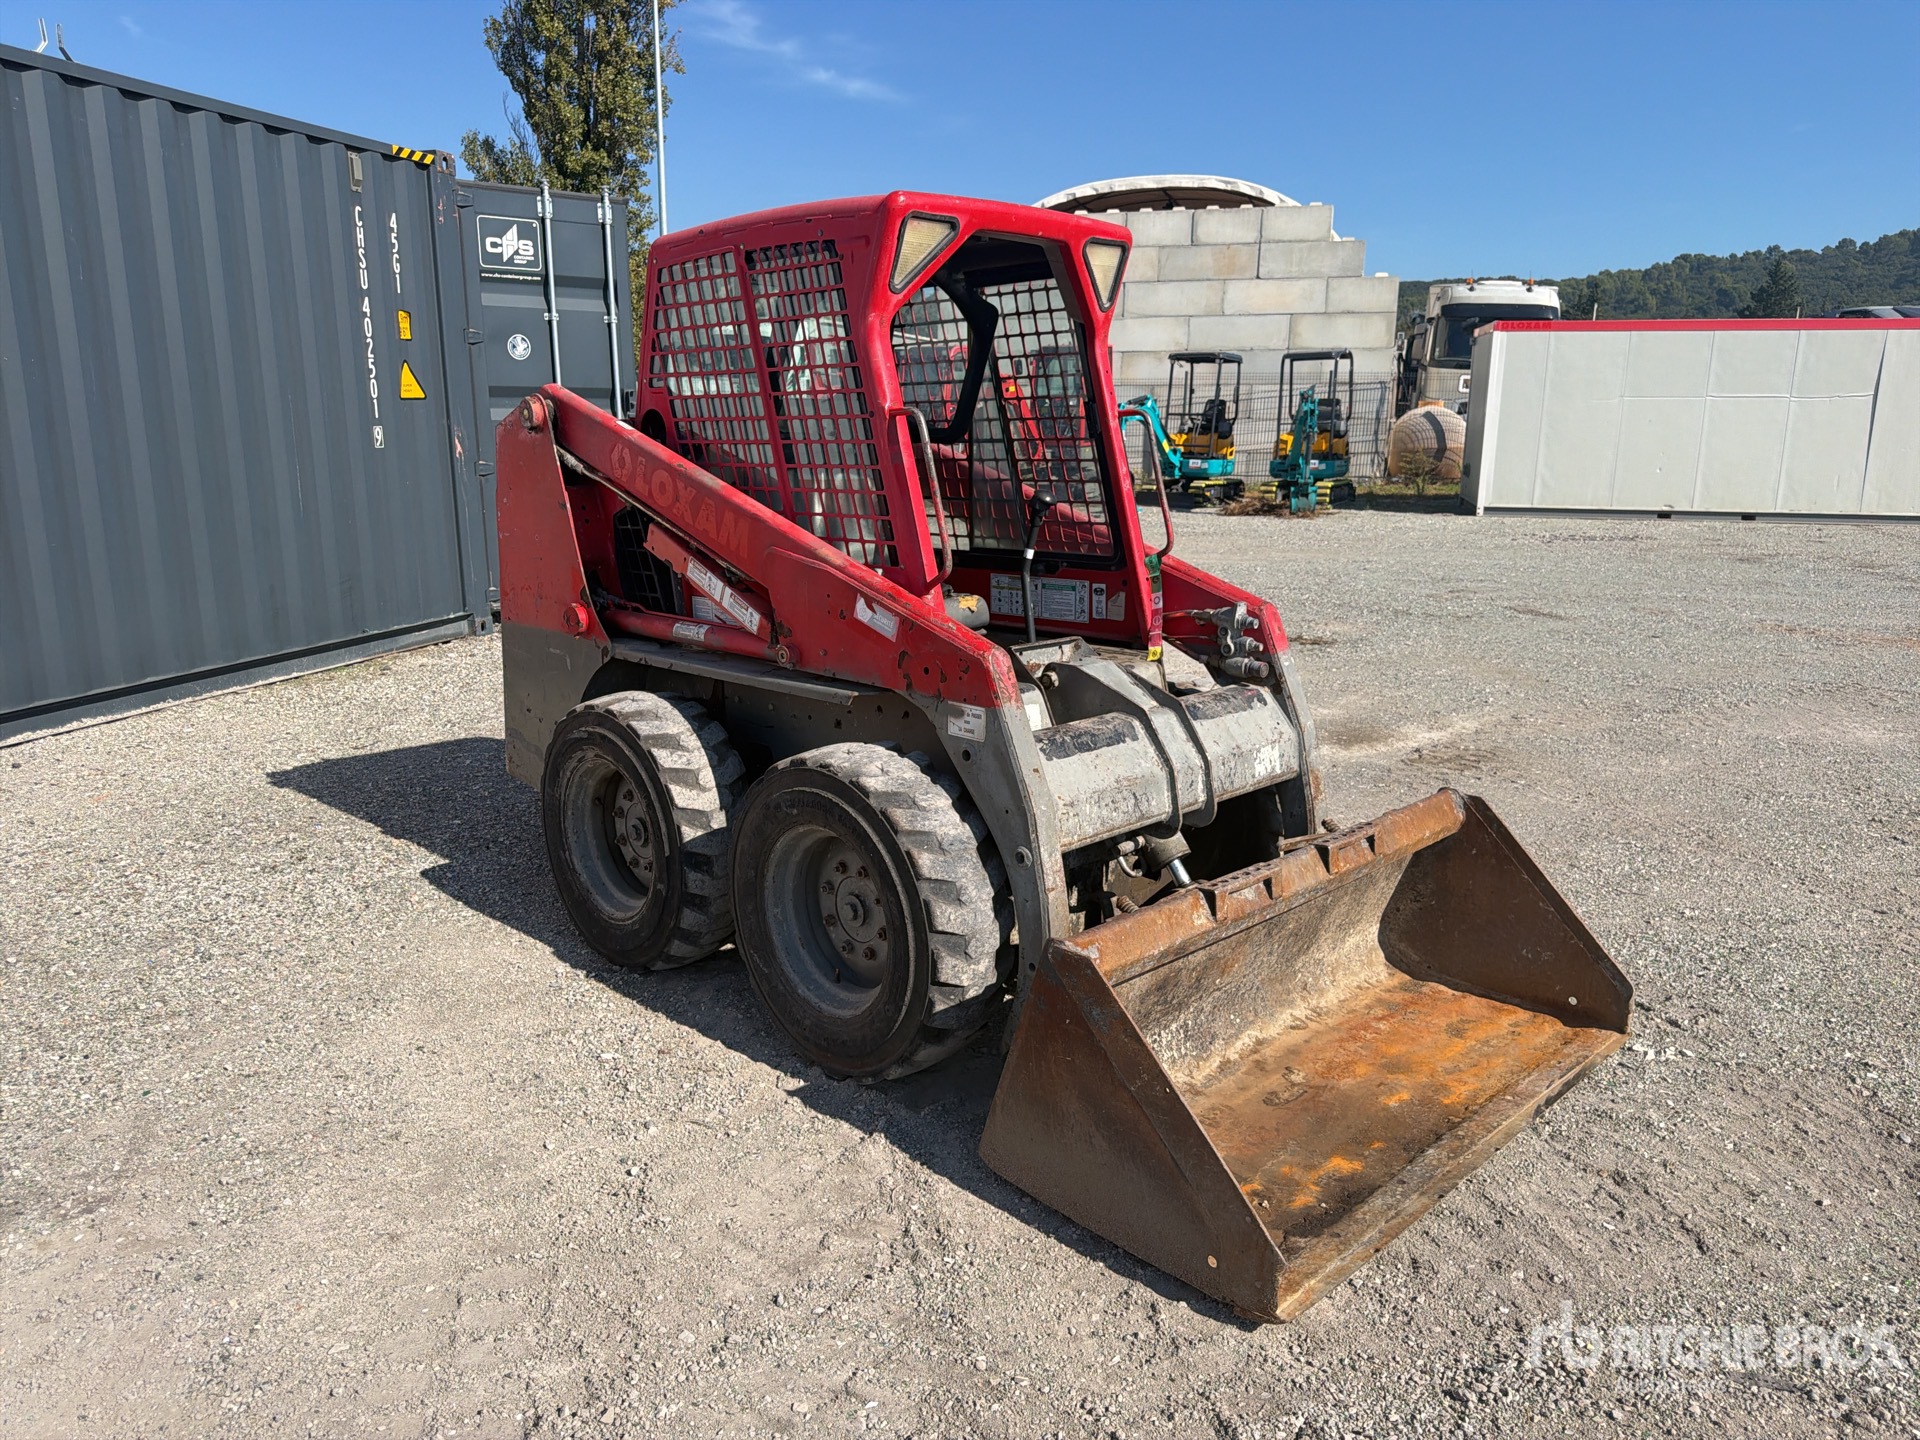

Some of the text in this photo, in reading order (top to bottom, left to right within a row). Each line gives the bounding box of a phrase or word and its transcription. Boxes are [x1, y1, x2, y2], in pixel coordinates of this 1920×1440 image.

[389, 212, 401, 294] 45G1
[485, 223, 534, 263] CHS
[354, 205, 369, 290] CHSU
[362, 296, 379, 419] 402501
[633, 455, 751, 561] LOXAM
